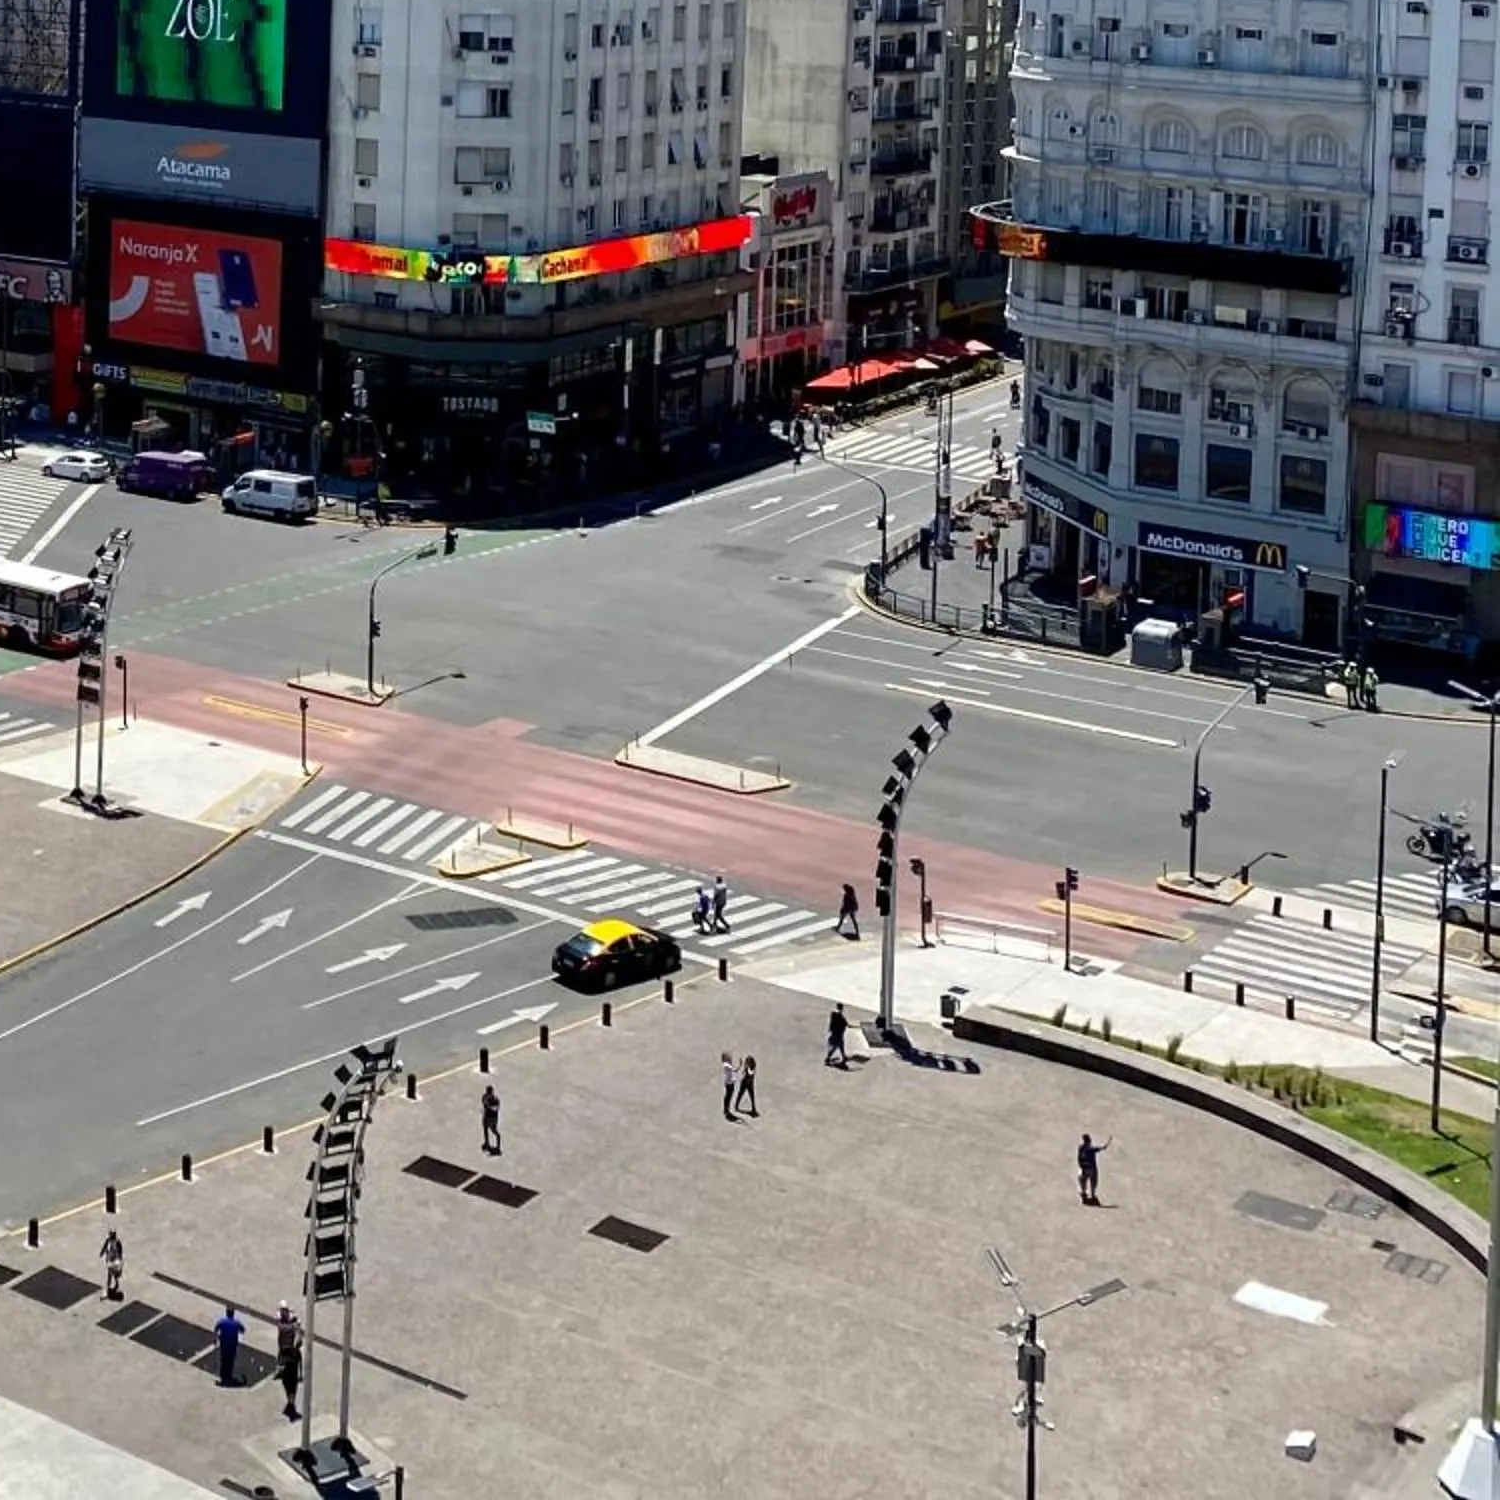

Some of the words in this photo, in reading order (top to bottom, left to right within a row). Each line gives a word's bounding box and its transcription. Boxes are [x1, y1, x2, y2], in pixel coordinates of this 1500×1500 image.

[157, 156, 231, 181] Atacama
[119, 236, 182, 264] Naranja
[92, 362, 128, 380] GIFTS
[1147, 532, 1243, 561] McDonald's
